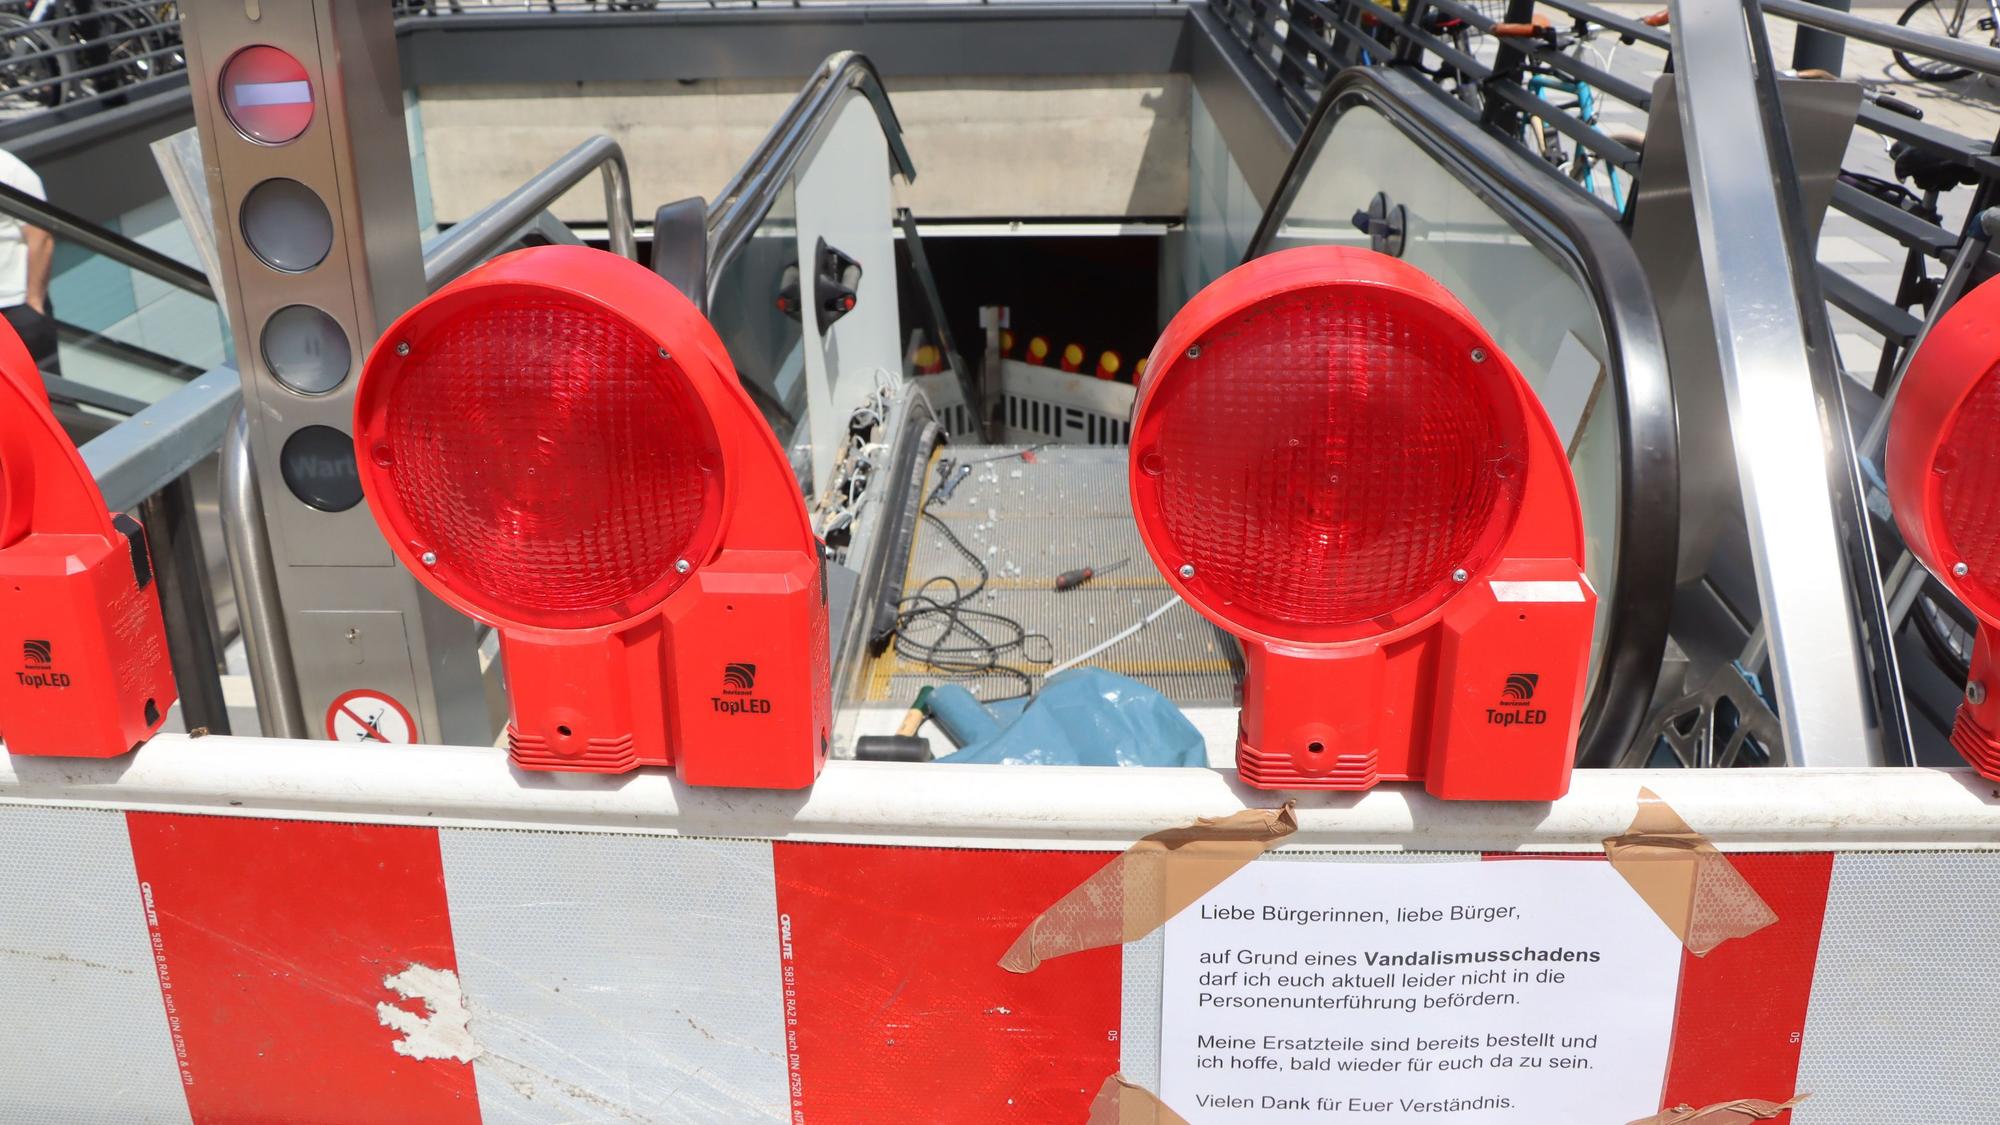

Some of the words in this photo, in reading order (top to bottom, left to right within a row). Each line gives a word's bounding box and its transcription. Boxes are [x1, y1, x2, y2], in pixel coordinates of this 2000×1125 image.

[287, 453, 357, 479] Wart
[15, 672, 71, 688] TopLED
[711, 697, 771, 716] TopLED
[1486, 709, 1547, 727] TopLED
[141, 881, 159, 927] ORALITE
[1201, 905, 1255, 920] Liebe
[1262, 905, 1390, 926] Bürgerinnen,
[1397, 907, 1444, 923] liebe
[1450, 905, 1521, 922] Bürger,
[780, 913, 793, 960] ORALITE
[1199, 948, 1232, 965] auf
[1236, 949, 1298, 966] Grund
[1304, 950, 1358, 967] eines
[1363, 946, 1601, 967] Vandalismusschadens
[1198, 970, 1238, 987] darf
[1243, 971, 1271, 987] ich
[1277, 972, 1325, 988] euch
[1331, 972, 1396, 989] aktuell
[1401, 972, 1456, 988] leider
[1461, 968, 1507, 986] nicht
[1512, 968, 1529, 983] in
[1535, 968, 1566, 984] die
[1198, 992, 1417, 1013] Personenunterführung
[1423, 991, 1520, 1009] befördern.
[169, 1016, 181, 1032] DIN
[173, 1033, 188, 1058] 67520
[788, 1030, 799, 1050] nach
[1197, 1034, 1257, 1050] Meine
[1263, 1035, 1364, 1052] Ersatzteile
[1369, 1036, 1410, 1052] sind
[1416, 1034, 1480, 1052] bereits
[1486, 1032, 1556, 1048] bestellt
[1561, 1034, 1598, 1049] und
[789, 1053, 800, 1070] DIN
[1197, 1054, 1224, 1070] ich
[1230, 1055, 1283, 1073] hoffe,
[1290, 1056, 1331, 1072] bald
[1337, 1057, 1402, 1072] wieder
[1407, 1057, 1433, 1073] für
[1438, 1054, 1484, 1071] euch
[1489, 1053, 1513, 1068] da
[1519, 1056, 1542, 1068] zu
[1548, 1054, 1593, 1070] sein.
[791, 1072, 803, 1097] 67520
[1195, 1093, 1254, 1109] Vielen
[1261, 1095, 1311, 1111] Dank
[1316, 1096, 1343, 1112] für
[1348, 1097, 1394, 1113] Euer
[1399, 1094, 1515, 1113] Verständnis.
